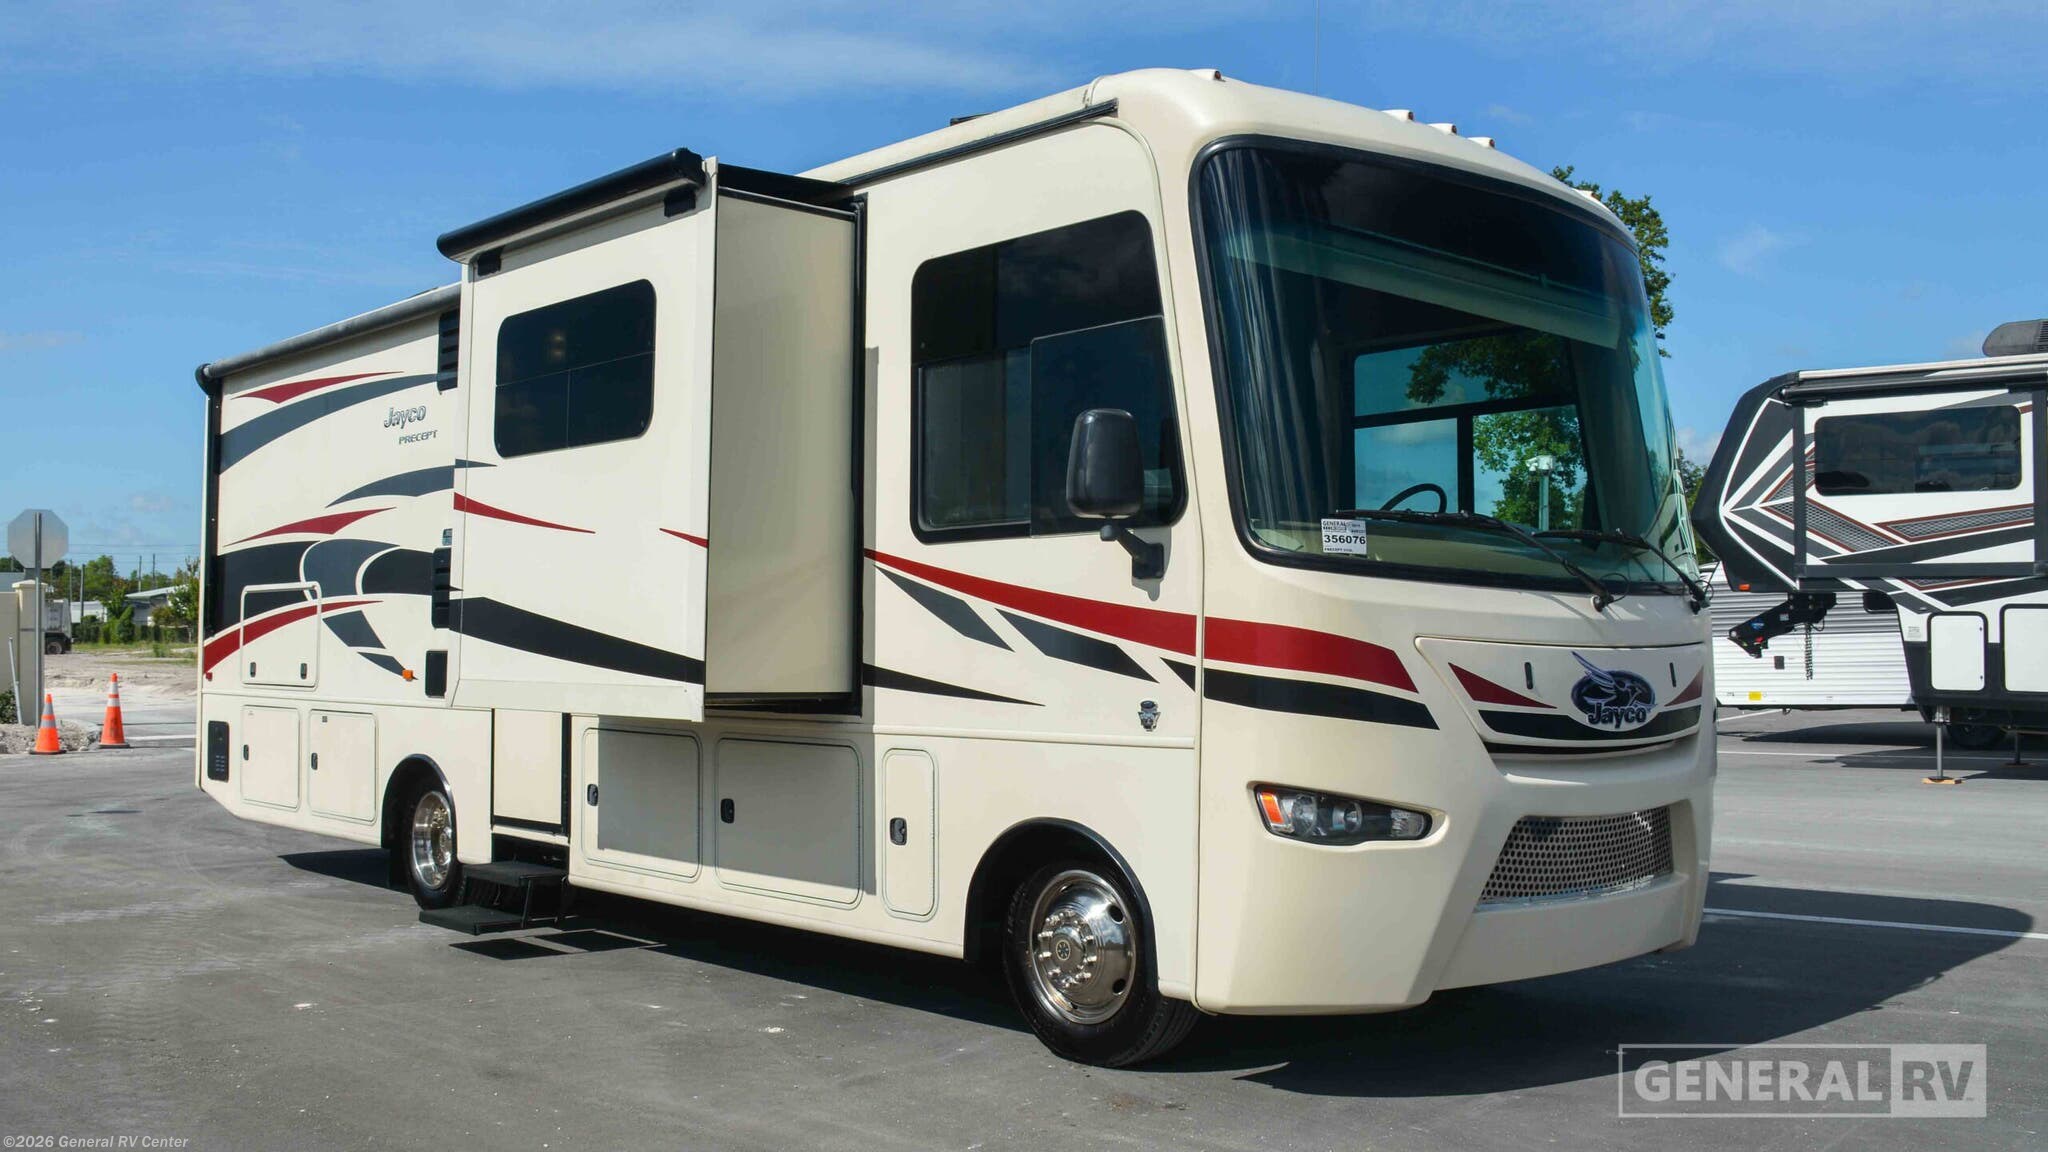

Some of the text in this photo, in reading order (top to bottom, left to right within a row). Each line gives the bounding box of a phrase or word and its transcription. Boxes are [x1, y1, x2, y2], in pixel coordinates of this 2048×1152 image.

[384, 406, 427, 429] Jayco
[399, 430, 438, 445] PRECEPT
[1324, 534, 1366, 545] 356076
[1588, 702, 1647, 729] Jayco
